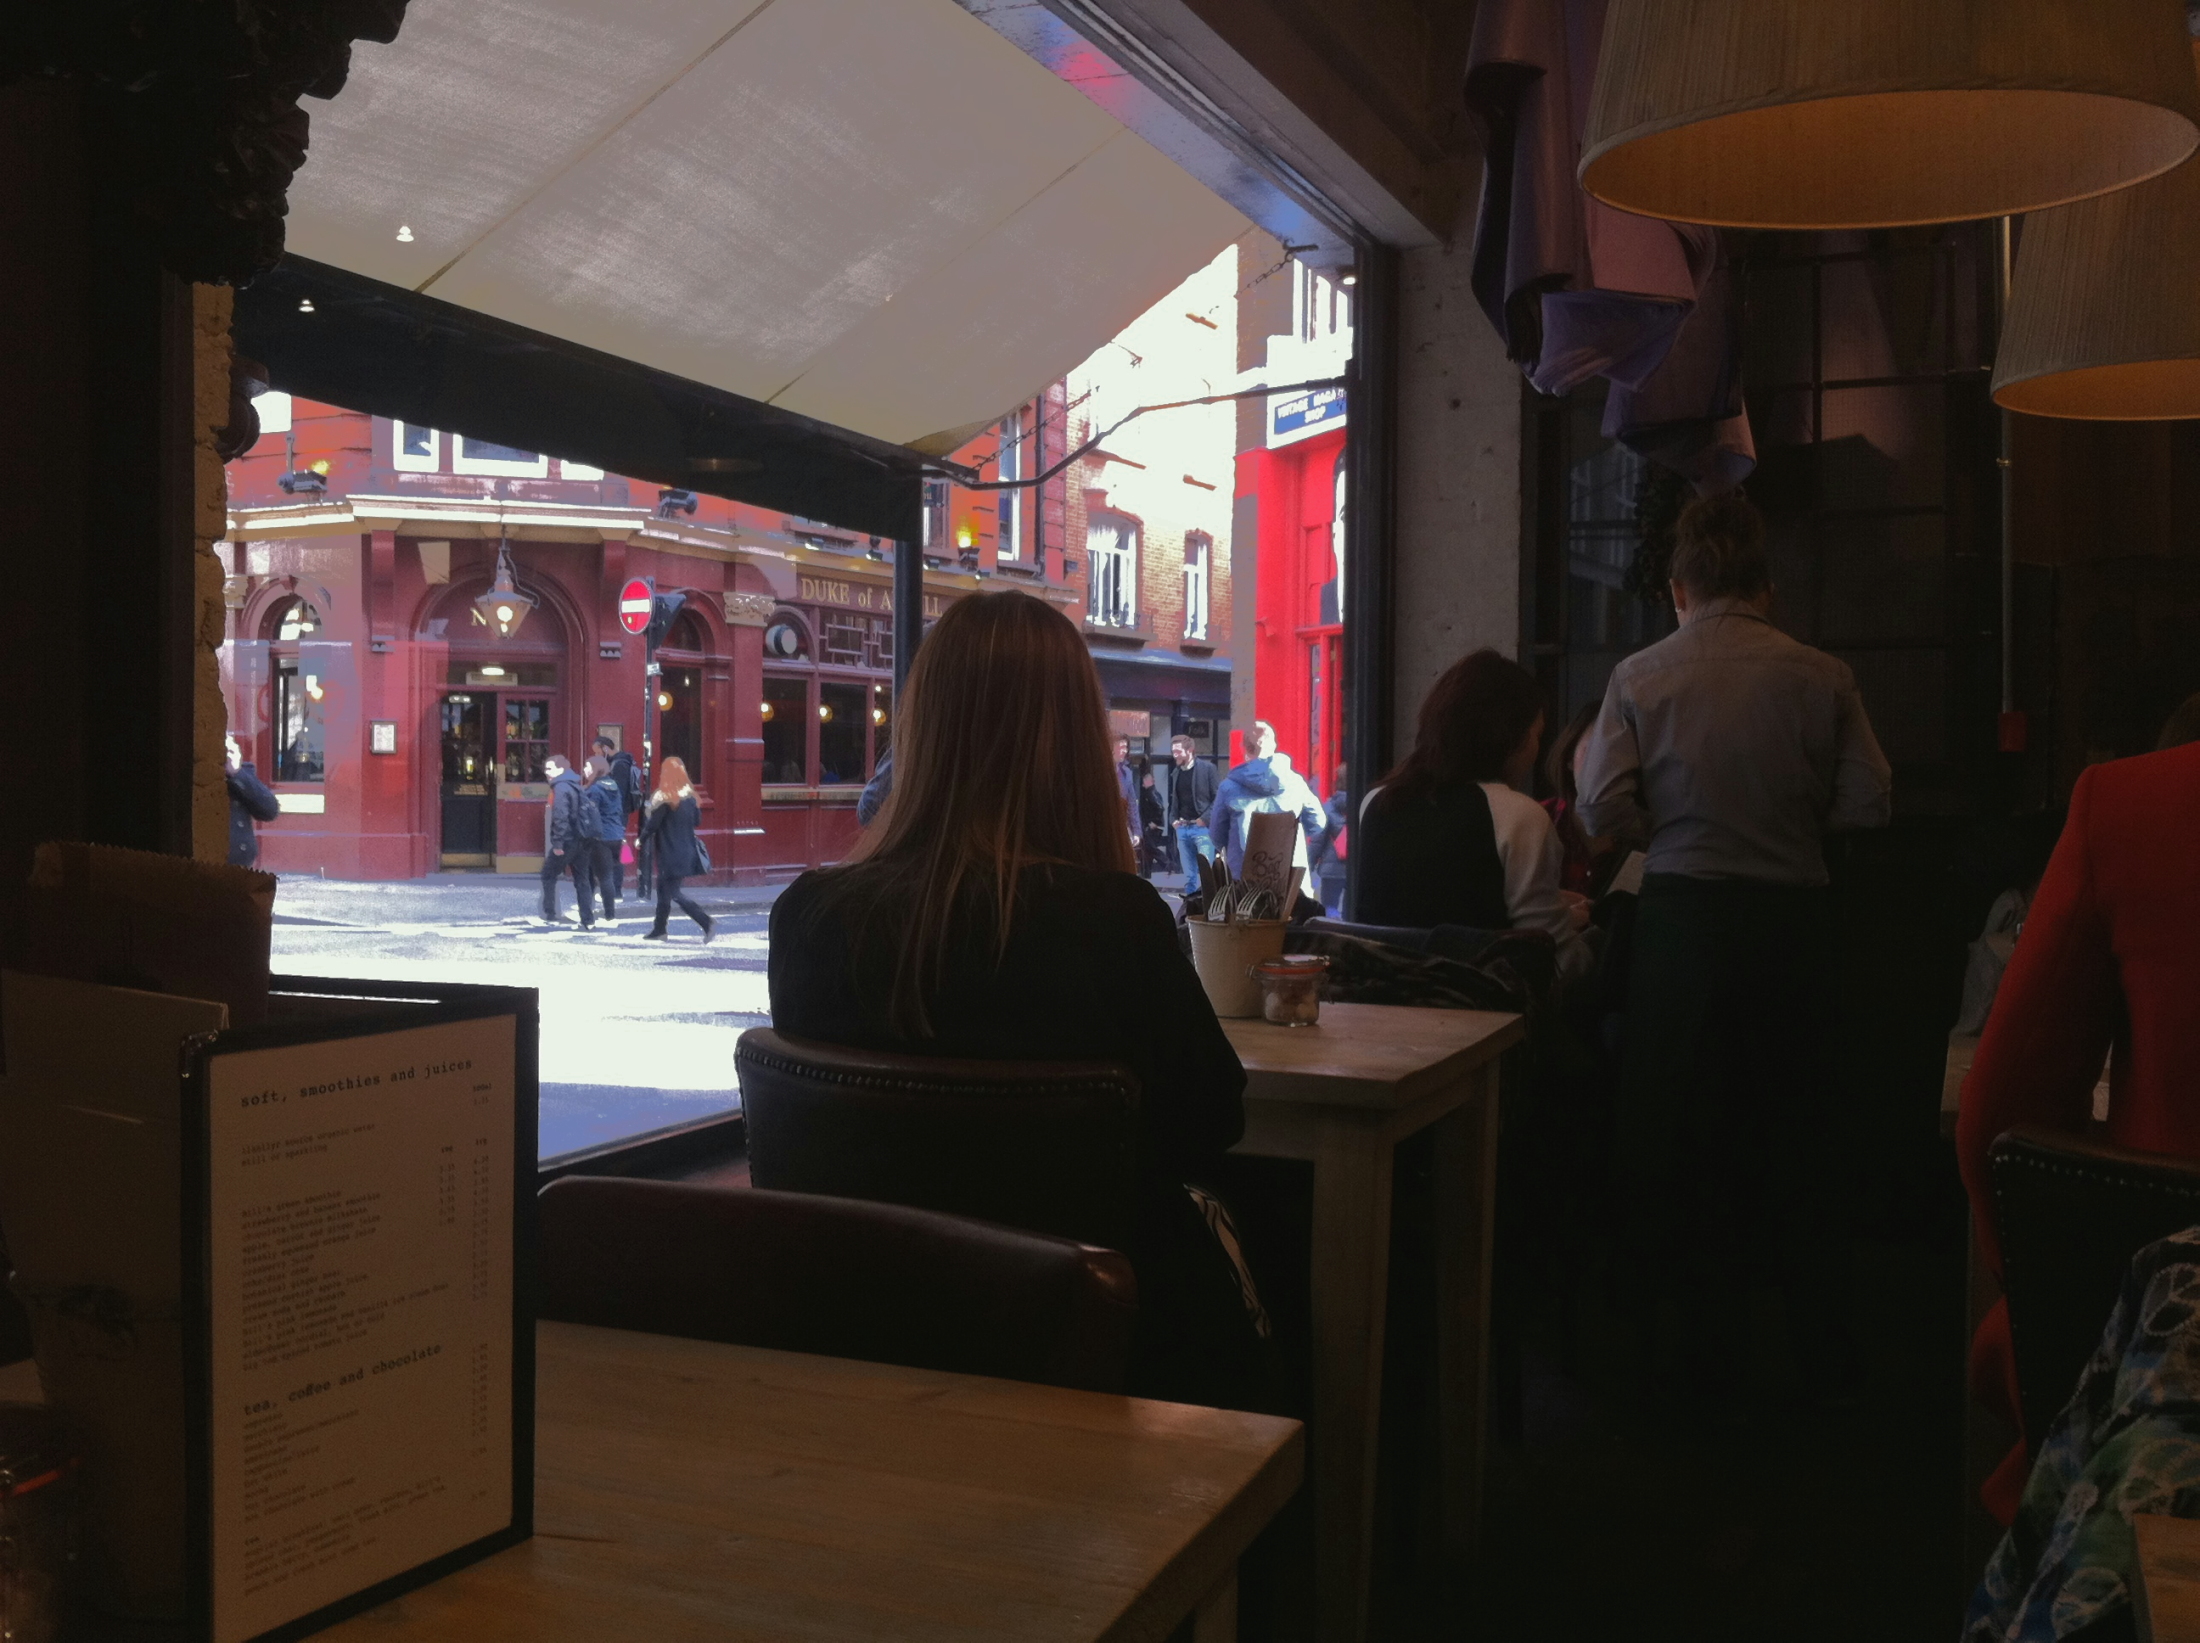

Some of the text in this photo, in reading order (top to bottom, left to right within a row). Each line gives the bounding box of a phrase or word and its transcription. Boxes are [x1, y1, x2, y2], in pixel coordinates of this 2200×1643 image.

[801, 578, 850, 606] DUKE
[858, 587, 873, 609] of
[240, 1056, 472, 1109] soft, smoothies and juices
[288, 1376, 331, 1403] coffee
[339, 1366, 363, 1386] and
[371, 1341, 441, 1376] chocolate
